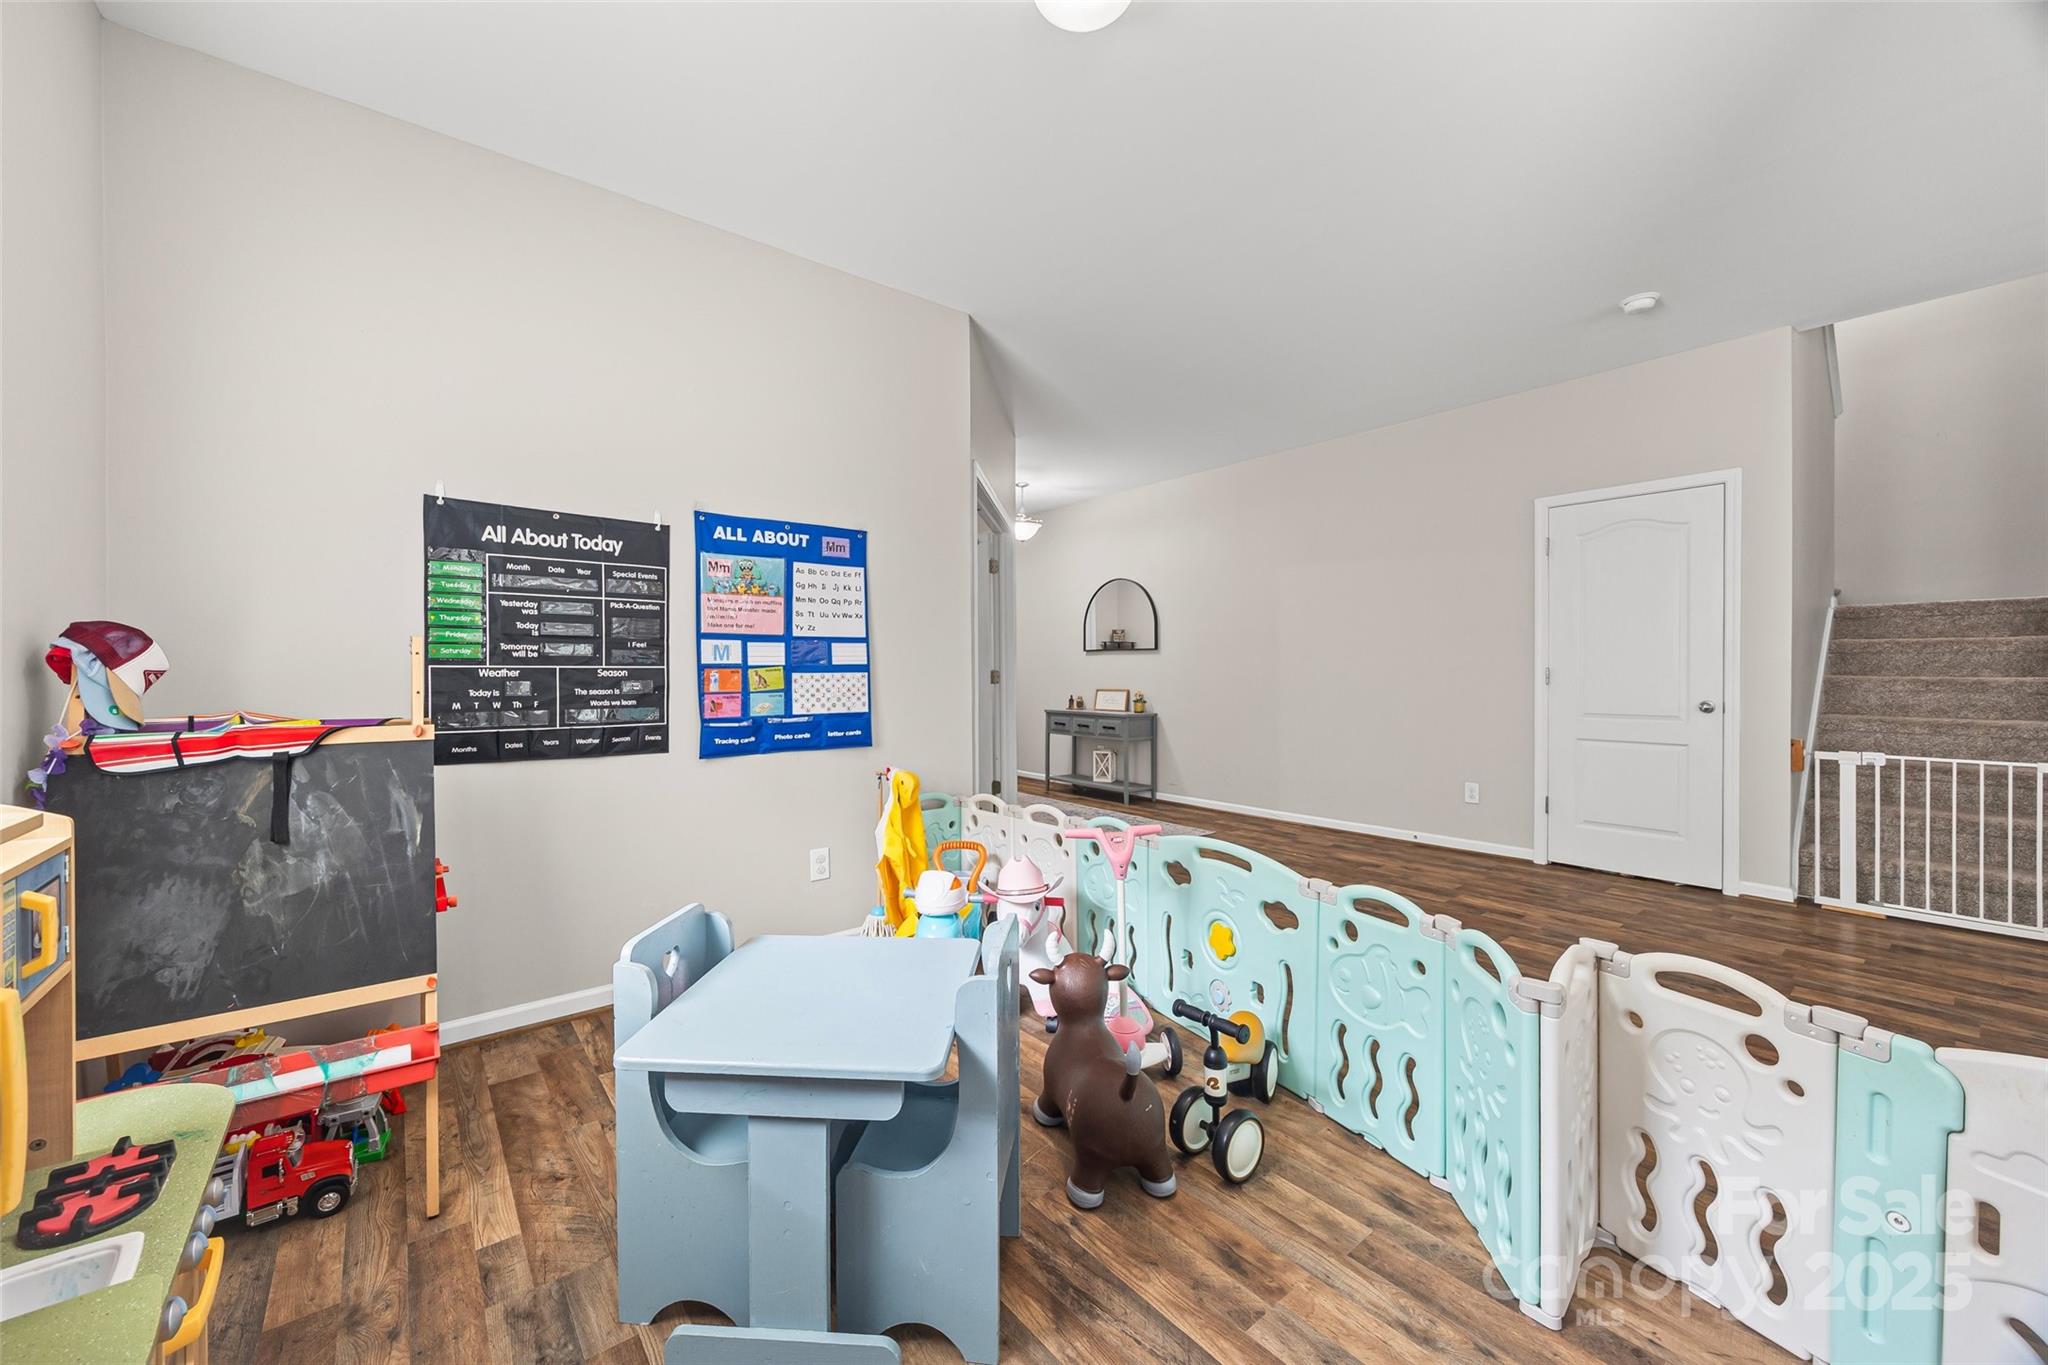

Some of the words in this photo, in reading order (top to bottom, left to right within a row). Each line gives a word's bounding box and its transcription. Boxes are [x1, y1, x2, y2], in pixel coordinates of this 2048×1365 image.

[481, 525, 506, 544] All
[511, 528, 568, 548] About
[571, 533, 623, 557] Today
[713, 526, 747, 542] ALL
[752, 530, 809, 548] ABOUT
[825, 541, 845, 553] Mm
[506, 562, 530, 572] Month
[548, 566, 565, 574] Date
[576, 568, 591, 576] Year
[708, 560, 730, 573] Mm
[612, 571, 636, 580] Special
[638, 572, 658, 580] Events
[440, 581, 472, 590] Tuesday
[833, 584, 839, 592] Jj
[500, 600, 538, 610] Yesterday
[610, 602, 660, 611] Pick-A-Question
[439, 614, 472, 623] Thursday
[516, 622, 539, 631] Today
[440, 647, 472, 656] Saturday
[500, 643, 539, 651] Tomorrow
[512, 650, 526, 658] will
[713, 644, 730, 661] M
[479, 669, 520, 677] Weather
[597, 669, 628, 677] Season
[468, 690, 491, 698] Today
[512, 701, 522, 709] Th
